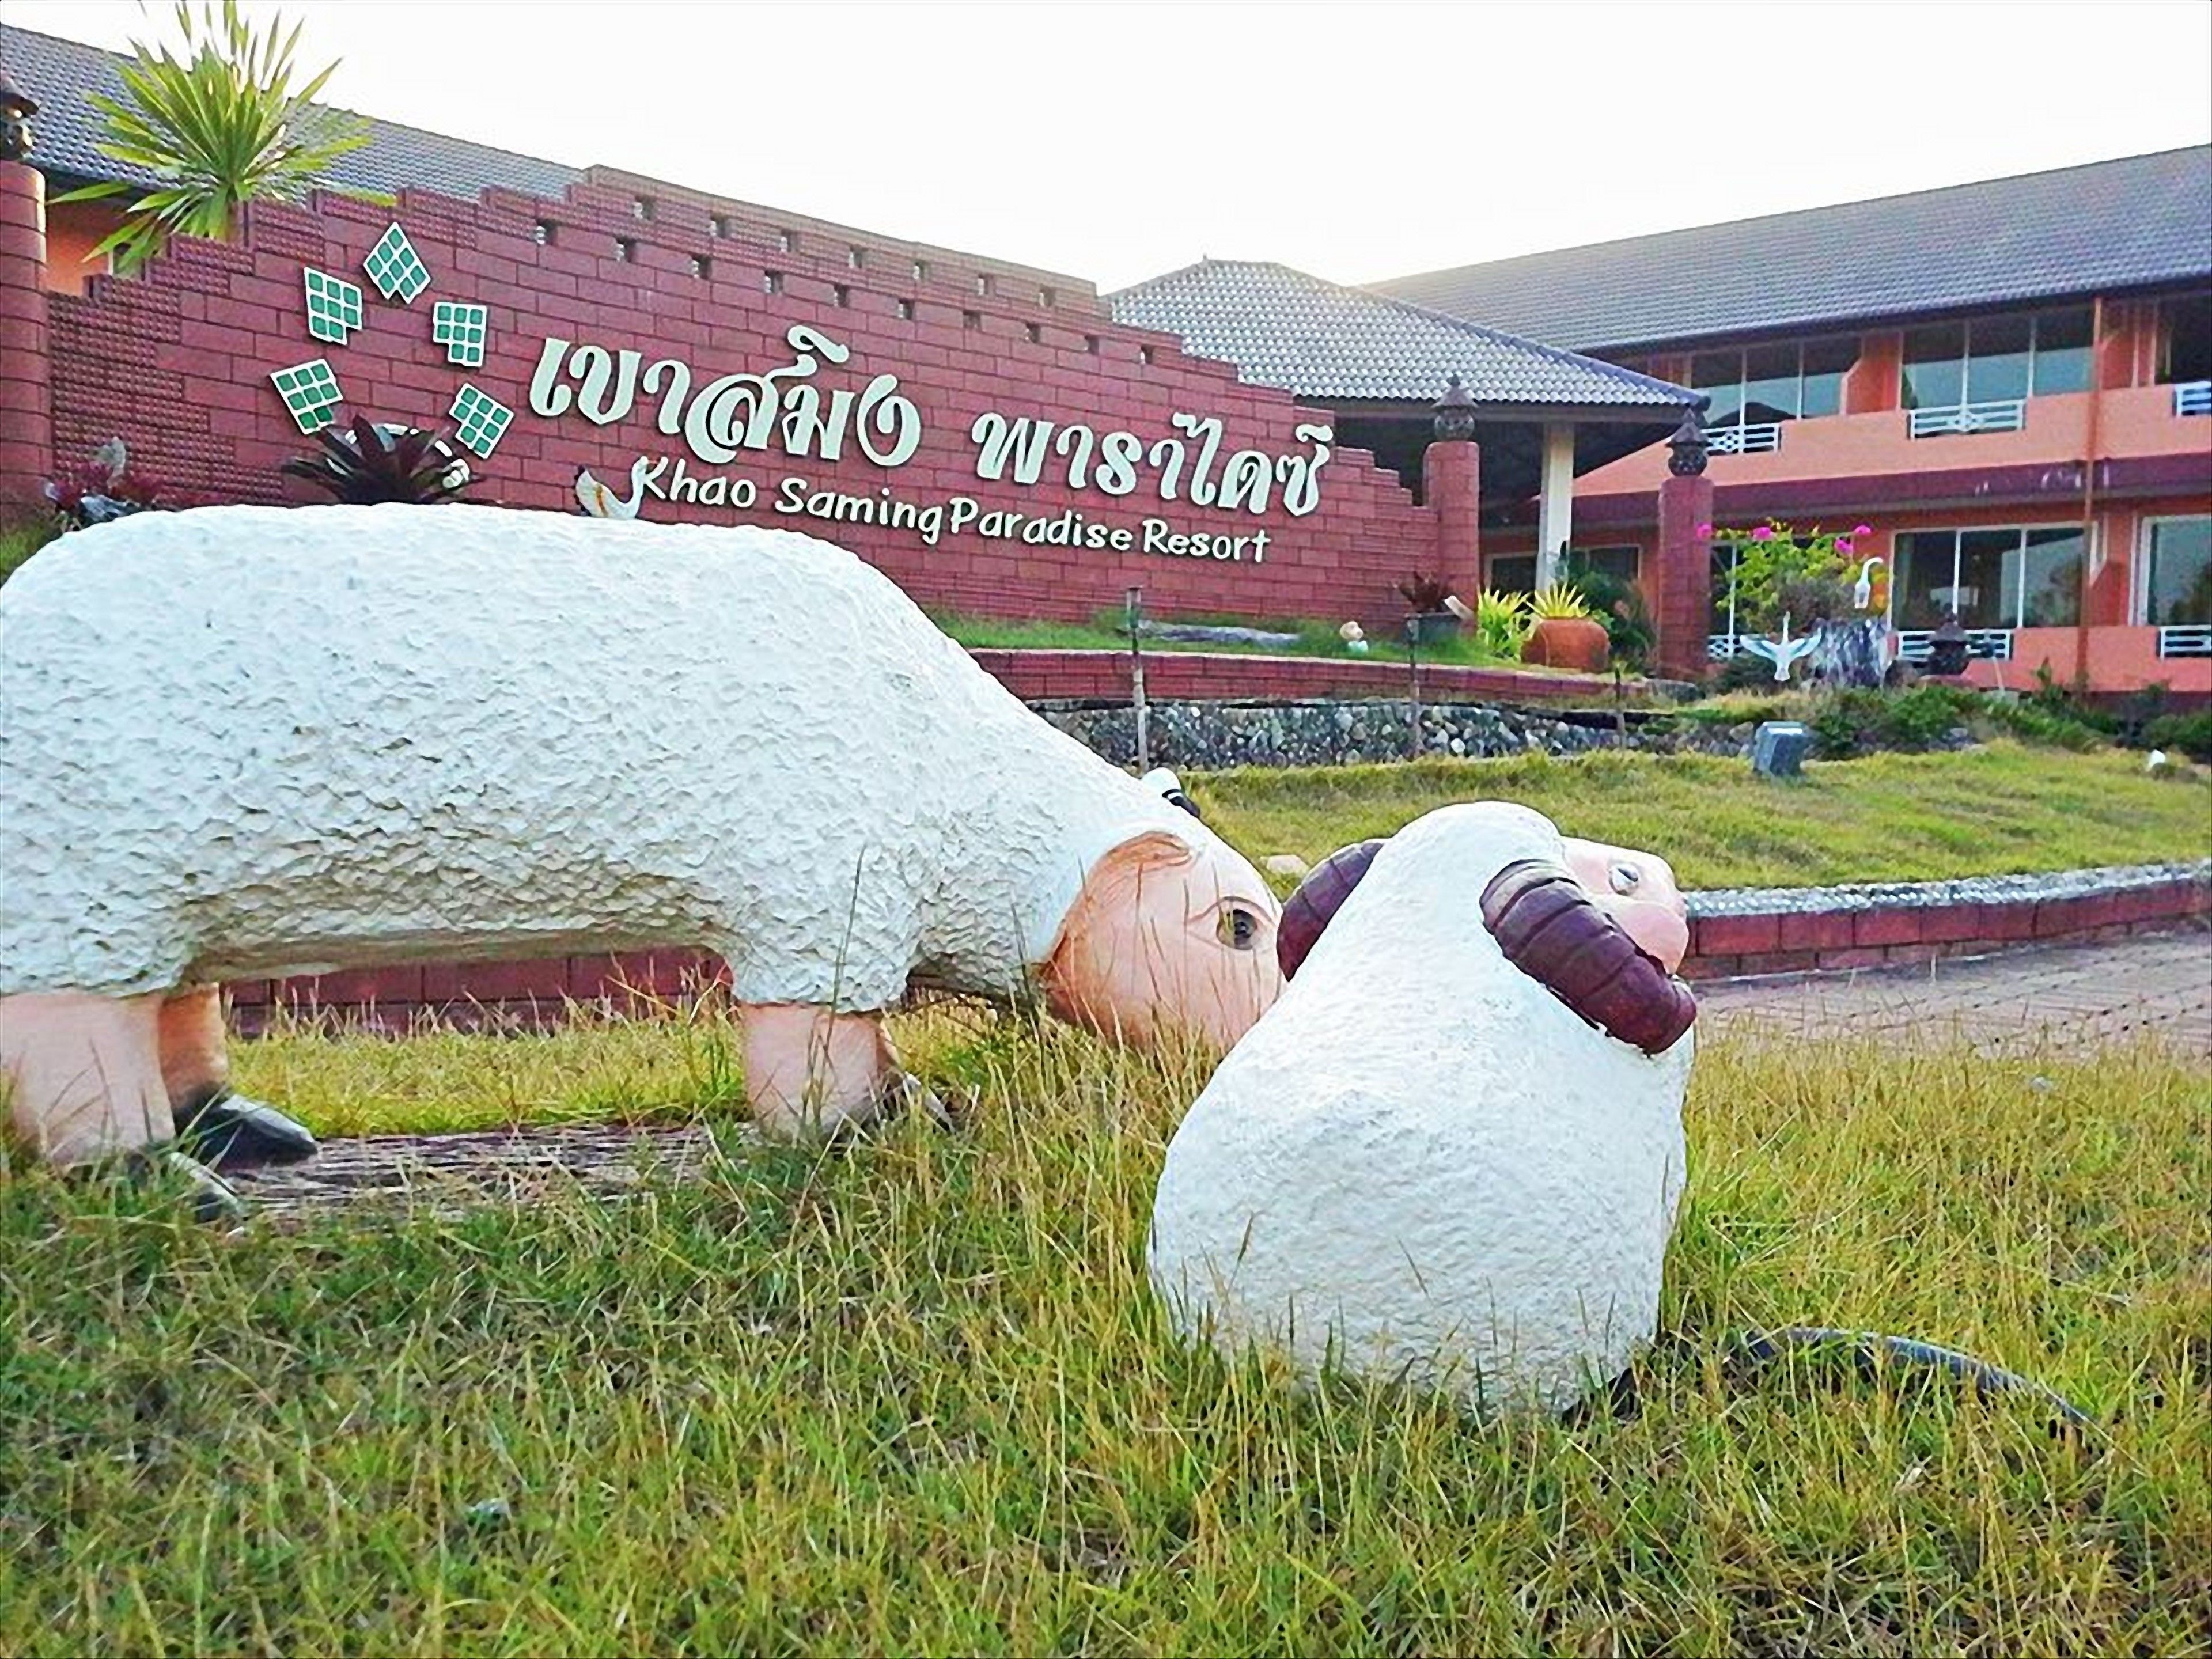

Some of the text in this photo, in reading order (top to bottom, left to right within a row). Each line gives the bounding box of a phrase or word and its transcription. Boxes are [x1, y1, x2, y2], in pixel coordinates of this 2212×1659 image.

[529, 324, 921, 467] เขาสมิง
[631, 455, 1272, 563] Khao Saming Paradise Resort
